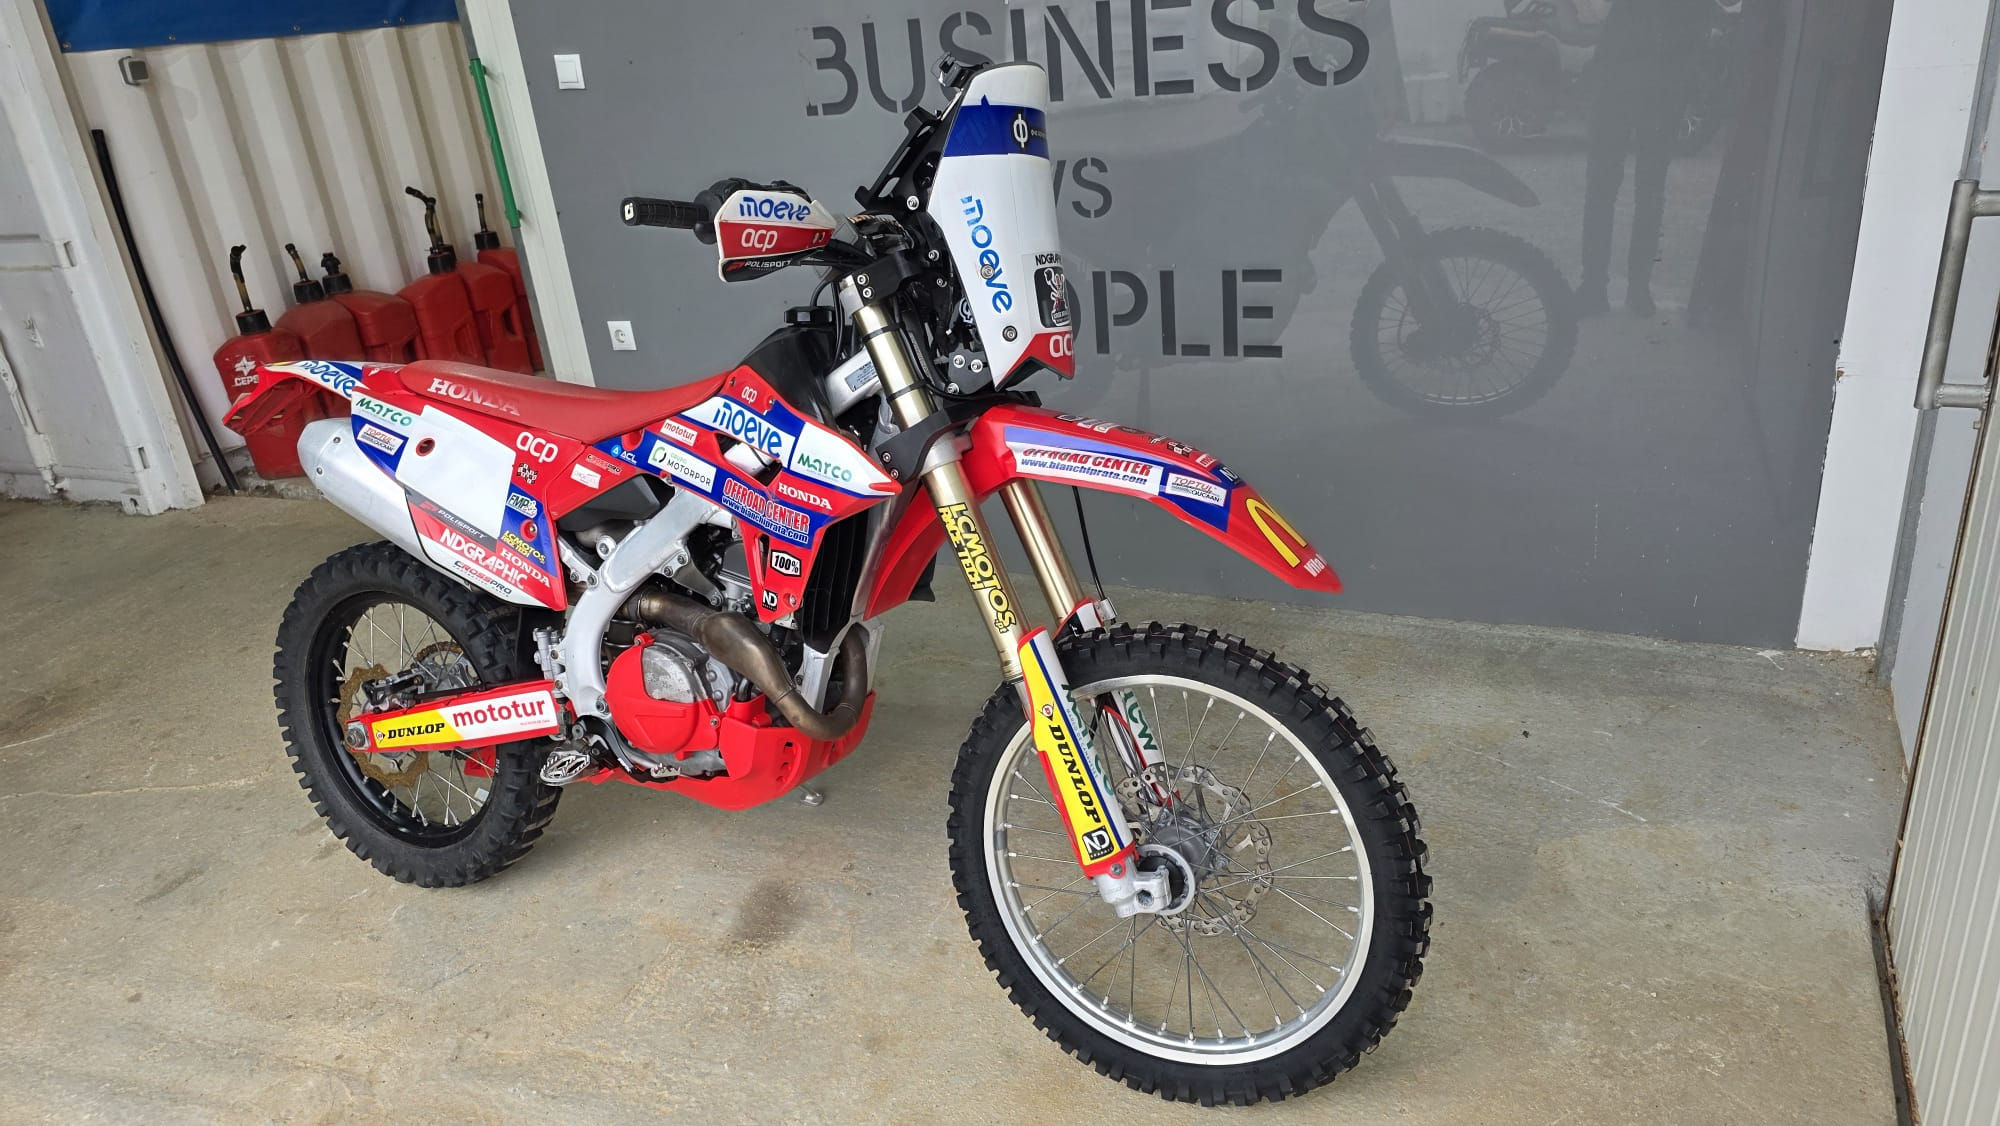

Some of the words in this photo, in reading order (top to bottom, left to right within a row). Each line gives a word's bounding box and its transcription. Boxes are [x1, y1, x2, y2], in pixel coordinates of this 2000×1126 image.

[739, 196, 811, 221] moeve
[741, 229, 777, 252] acp
[959, 194, 1013, 313] moeve
[1049, 333, 1072, 358] ac
[232, 375, 259, 386] CEPS
[741, 386, 757, 403] acp
[664, 422, 695, 440] mototur
[712, 401, 783, 457] moeve
[516, 431, 559, 463] acp
[620, 449, 637, 463] ACL
[1023, 448, 1089, 465] OFFROAD
[1092, 455, 1153, 477] CENTER
[723, 478, 767, 517] OFFROAD
[765, 498, 810, 533] CENTER
[778, 482, 833, 510] HONDA
[440, 527, 528, 589] NDGRAPHIC
[500, 547, 550, 588] HONDA
[774, 554, 799, 574] 100%
[949, 502, 1016, 628] LCMOTOS
[453, 560, 512, 595] CROSSPRO
[453, 698, 546, 728] mototur
[387, 722, 446, 740] DUNLOP
[1048, 724, 1102, 824] DUNLOP
